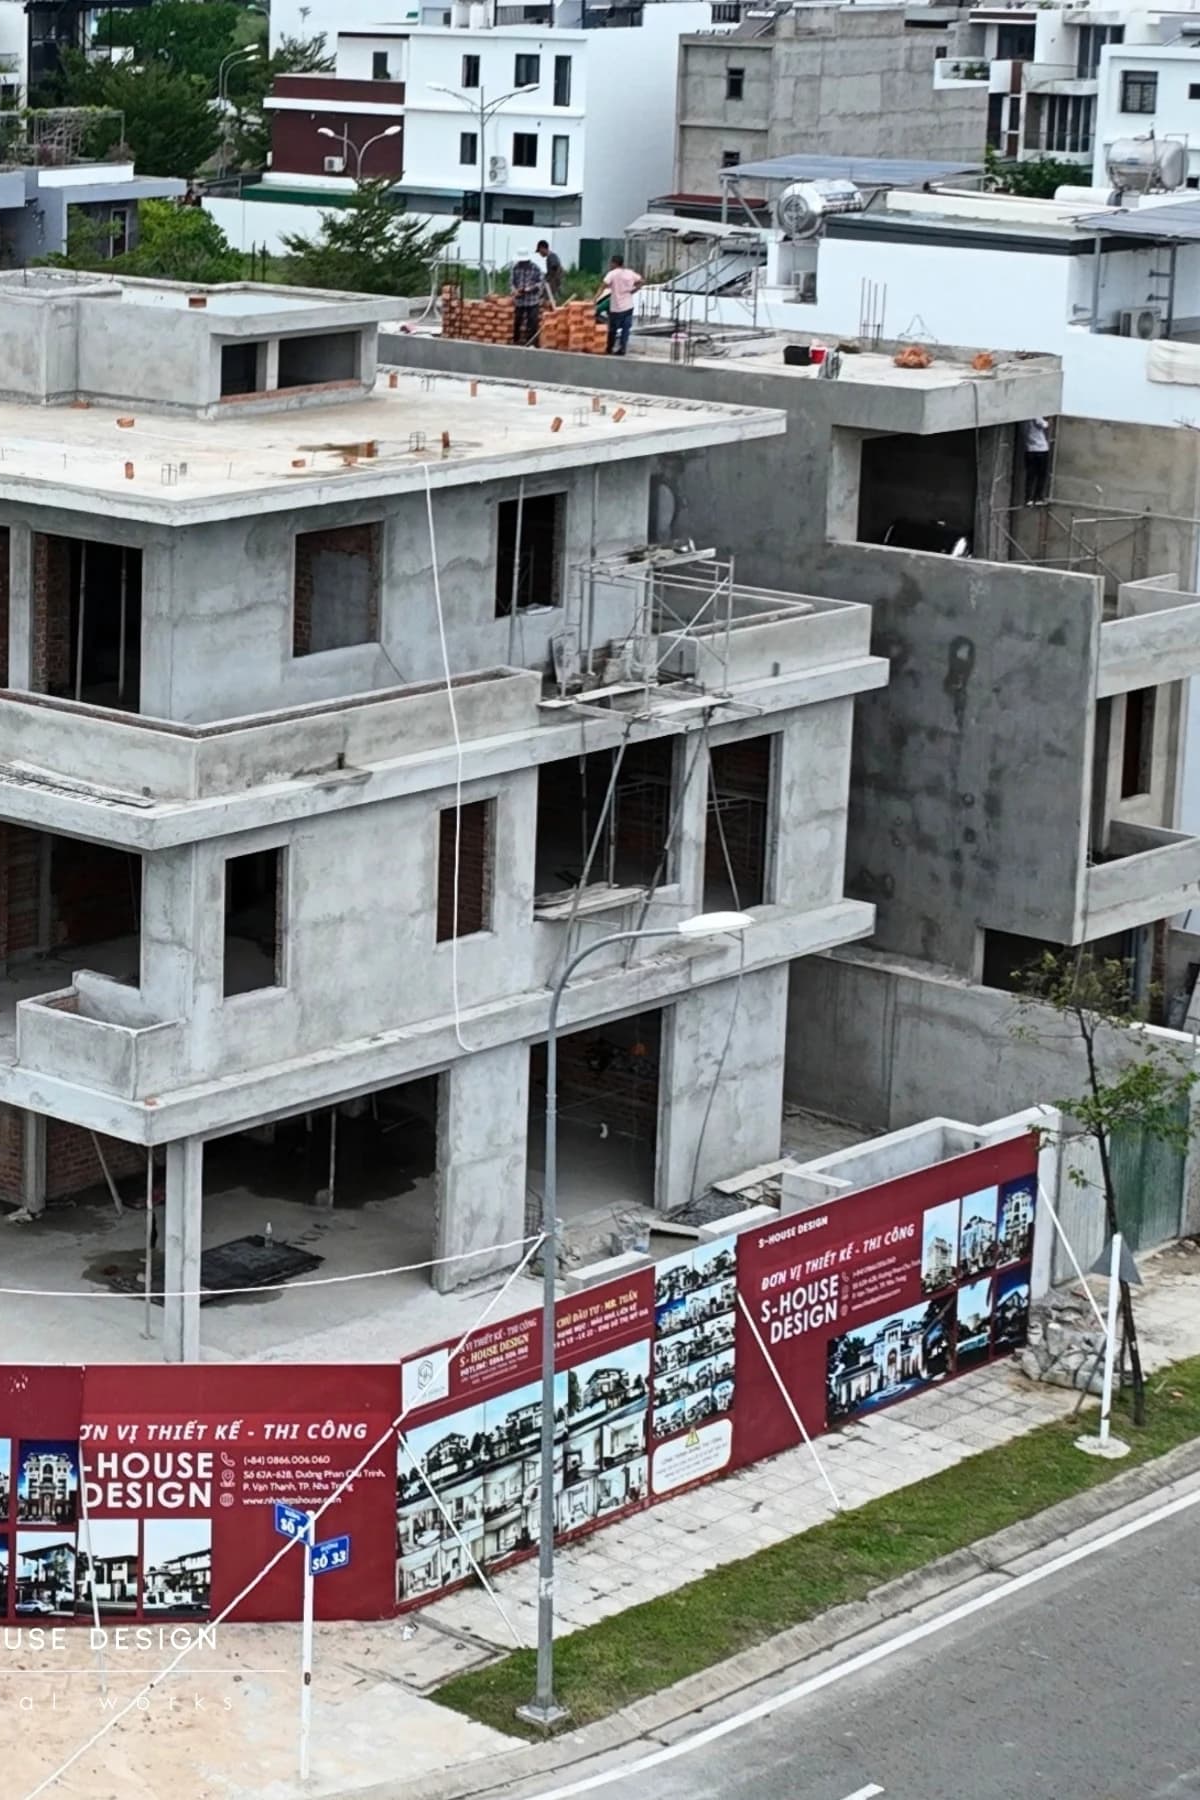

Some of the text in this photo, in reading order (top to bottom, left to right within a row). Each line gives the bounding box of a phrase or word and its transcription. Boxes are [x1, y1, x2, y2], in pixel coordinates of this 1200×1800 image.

[758, 1216, 828, 1248] S-HOUSE DESIGN
[789, 1264, 802, 1281] VỊ
[863, 1235, 882, 1253] THI
[884, 1223, 915, 1245] CÔNG
[761, 1274, 839, 1323] S-HOUSE
[770, 1299, 838, 1344] DESIGN
[117, 1424, 139, 1444] VỊ
[147, 1420, 208, 1440] THIẾT
[214, 1419, 244, 1440] KẾ
[264, 1424, 300, 1440] THI
[307, 1419, 367, 1440] CÔNG
[346, 1469, 362, 1478] Cu
[84, 1481, 211, 1509] DESIGN
[331, 1550, 346, 1565] 33
